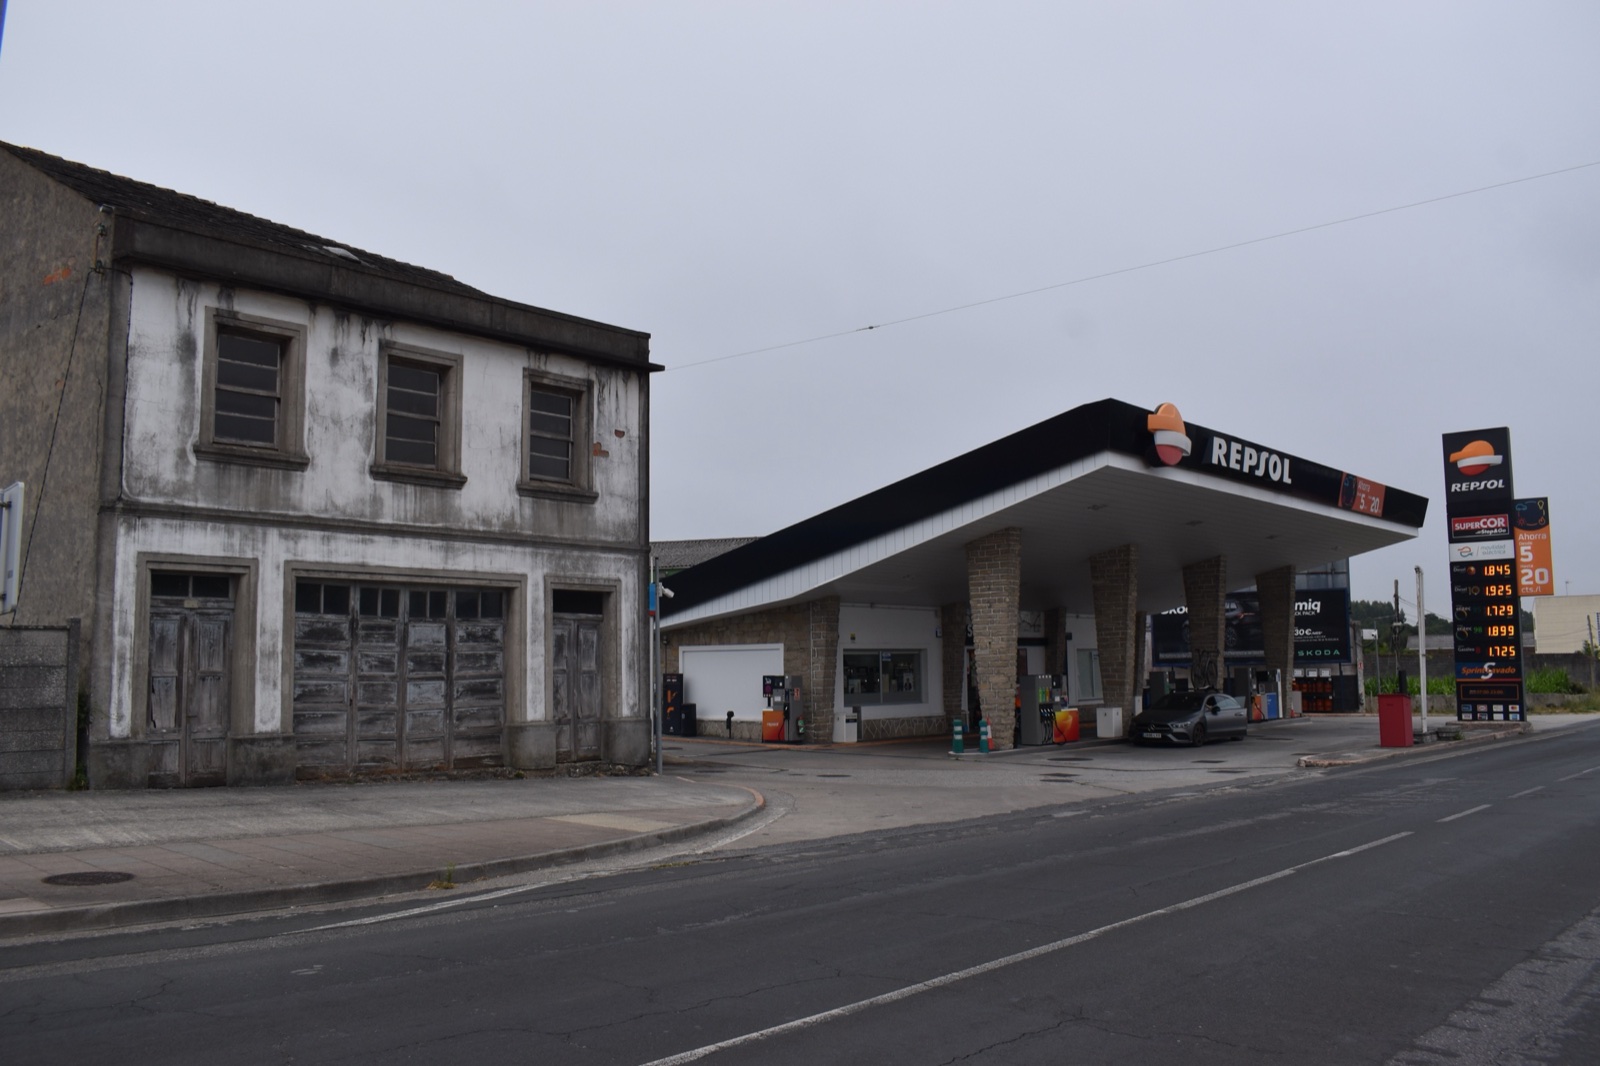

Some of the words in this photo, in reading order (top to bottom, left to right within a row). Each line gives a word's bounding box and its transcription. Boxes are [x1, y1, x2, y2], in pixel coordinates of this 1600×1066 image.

[1211, 436, 1292, 484] REPSOL
[1451, 479, 1505, 492] REPSOL
[1360, 494, 1366, 509] 5
[1370, 496, 1380, 513] 20
[1454, 517, 1506, 530] SUPERCOR
[1520, 545, 1533, 562] 5
[1484, 564, 1511, 576] 1.845
[1520, 567, 1549, 585] 20
[1486, 584, 1512, 596] 1.925
[1487, 604, 1513, 616] 1.729
[1489, 625, 1514, 637] 1.899
[1489, 645, 1515, 657] 1.725
